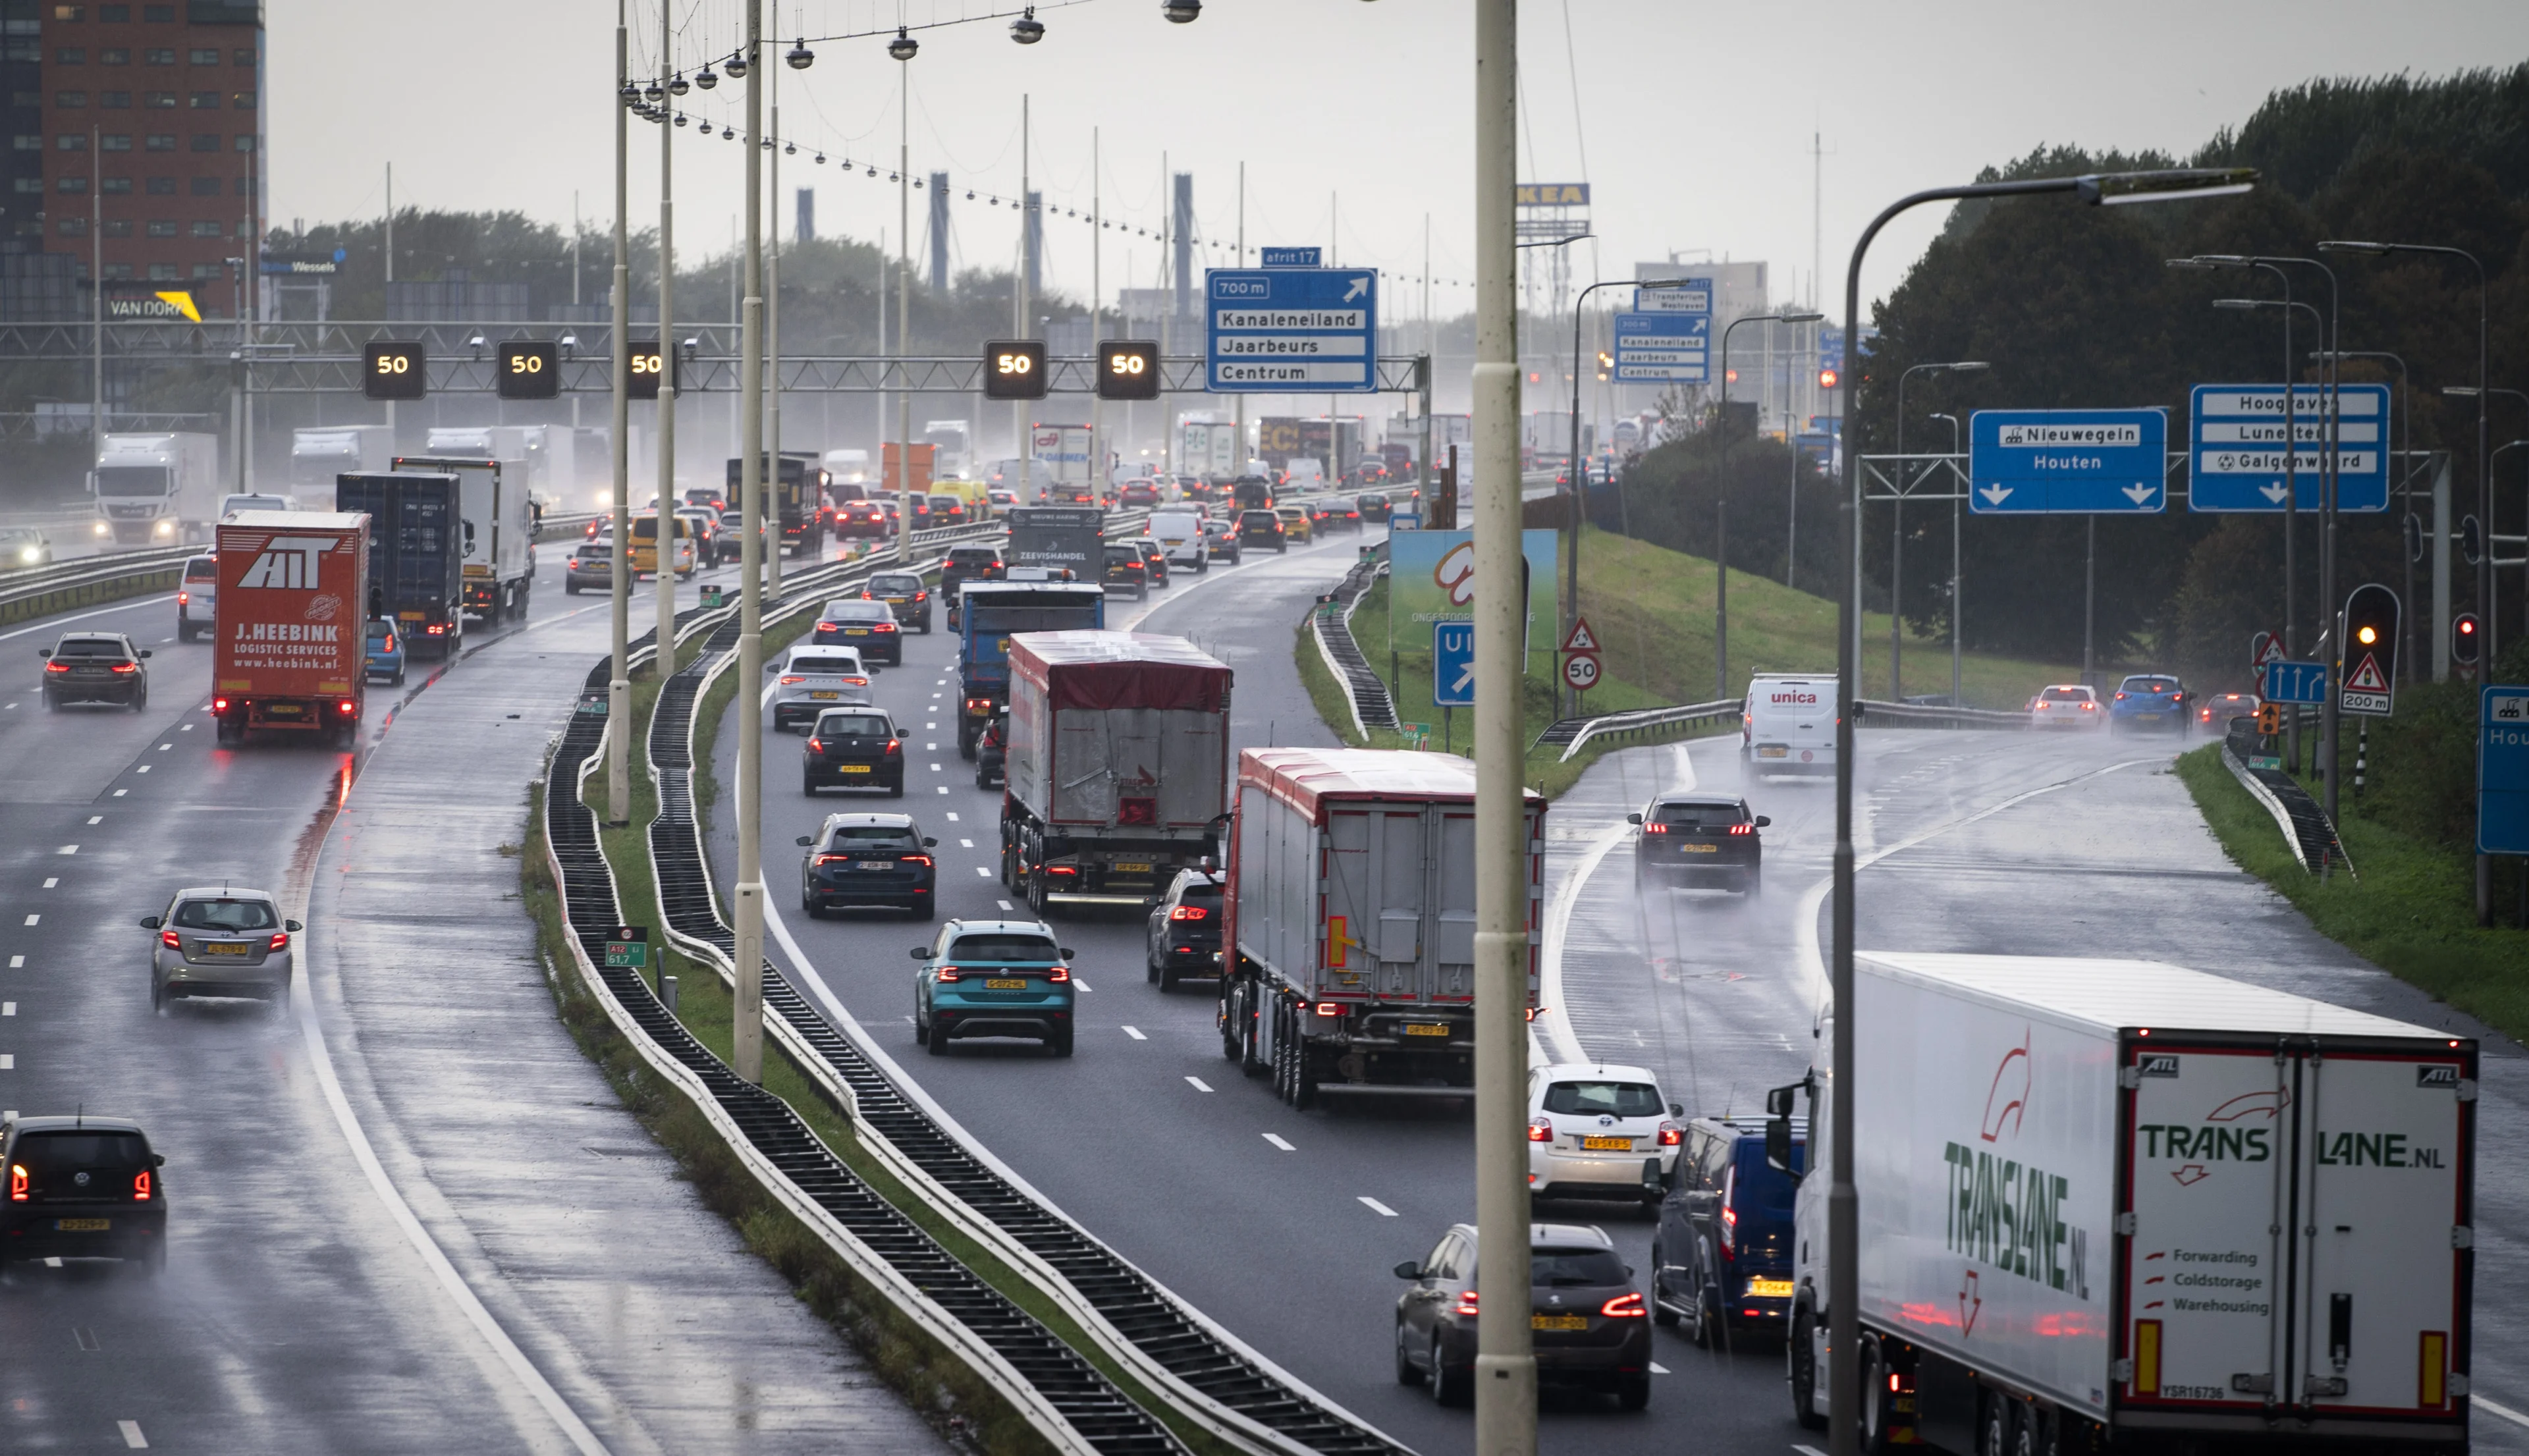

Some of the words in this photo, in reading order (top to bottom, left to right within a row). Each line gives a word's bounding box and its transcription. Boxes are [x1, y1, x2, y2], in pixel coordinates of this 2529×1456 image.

[1517, 186, 1583, 203] KEA
[1266, 252, 1295, 263] afrit
[1300, 252, 1315, 263] 17
[292, 260, 336, 273] Wessels
[1220, 283, 1248, 294] 700
[1251, 284, 1264, 293] m
[111, 300, 140, 315] VAN
[1222, 313, 1356, 327] Kanaleneiland
[1222, 340, 1319, 353] Jaarbeurs
[1623, 338, 1700, 347] Kanaleneiland
[377, 356, 408, 374] 50
[511, 356, 542, 374] 50
[631, 356, 663, 374] 50
[998, 356, 1031, 374] 50
[1111, 356, 1144, 374] 50
[1222, 366, 1305, 379] Centrum
[1622, 368, 1670, 377] Centrum
[2240, 396, 2340, 414] Hoogave
[2027, 428, 2135, 444] Nieuwegein
[2239, 427, 2322, 439] Lunete
[2034, 456, 2101, 469] Houten
[2239, 454, 2360, 471] Galgenwrd
[236, 624, 338, 641] J.HEEBINK
[234, 644, 283, 654] LOGISTIC
[286, 645, 337, 655] SERVICES
[1445, 633, 1472, 652] UI
[234, 659, 337, 669] www.heebink.nl
[1570, 664, 1594, 678] 50
[1772, 689, 1816, 703] unica
[2345, 695, 2371, 707] 200
[2375, 699, 2386, 709] m
[2490, 729, 2529, 745] Hou
[2146, 1059, 2176, 1072] ATL
[2423, 1069, 2455, 1081] ATL
[2138, 1124, 2270, 1162] TRANS
[2318, 1131, 2446, 1170] LANE.NL
[1944, 1141, 2089, 1301] TRANSLANE.NL
[2174, 1250, 2258, 1267] Forwarding
[2174, 1274, 2262, 1291] Coldstorage
[2174, 1299, 2269, 1316] Warehousing
[2163, 1386, 2223, 1399] YSR16736
